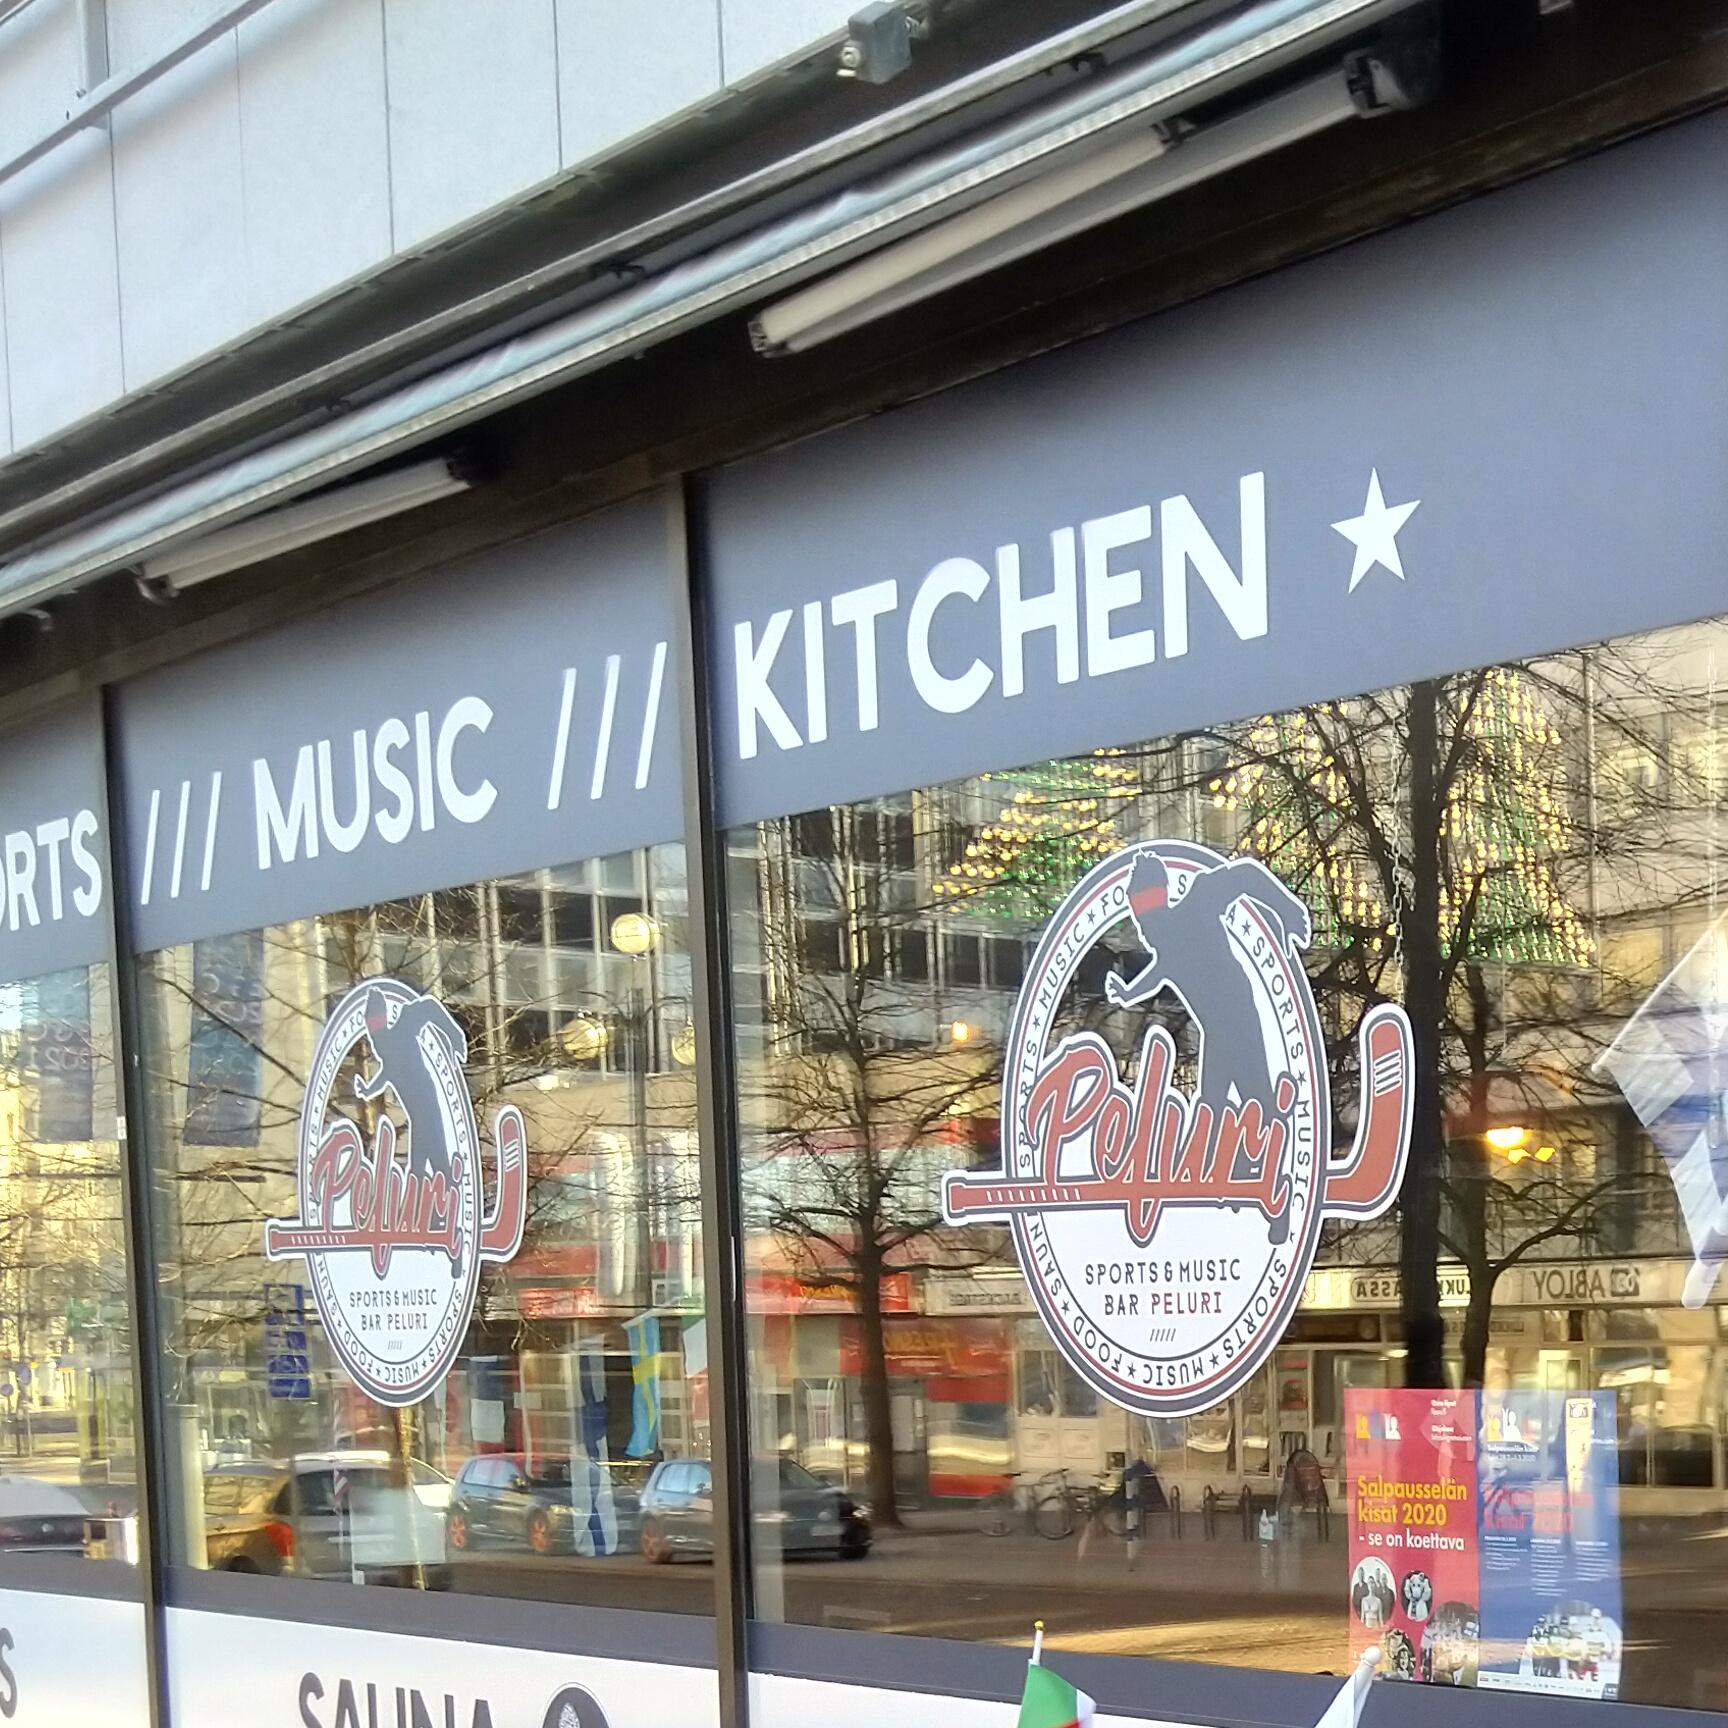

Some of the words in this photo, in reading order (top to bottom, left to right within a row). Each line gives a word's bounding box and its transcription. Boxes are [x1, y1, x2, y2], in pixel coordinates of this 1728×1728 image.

[0, 808, 104, 933] RTS
[253, 695, 498, 870] MUSIC
[733, 470, 1269, 760] KITCHEN
[1039, 927, 1086, 1011] MUSIC
[1101, 885, 1125, 913] FO
[318, 1041, 342, 1100] MUSIC
[435, 1053, 466, 1143] SPORTS
[1251, 936, 1304, 1060] SPORTS
[1293, 1100, 1312, 1208] MUSIC
[1027, 1036, 1293, 1240] Peluri
[311, 1118, 466, 1278] Peluri
[317, 1254, 337, 1316] SAUN
[344, 1330, 374, 1371] FOOD
[385, 1367, 420, 1383] MUSIC
[361, 1315, 382, 1331] BAR
[387, 1313, 428, 1330] PELURI
[1029, 1212, 1062, 1297] SAUN
[1073, 1316, 1123, 1374] FOOD
[1143, 1360, 1205, 1387] MUSIC
[1223, 1258, 1288, 1355] SPORTS
[1104, 1294, 1139, 1316] BAR
[1151, 1291, 1222, 1315] PELURI
[1357, 1475, 1467, 1501] Salpausselän
[1358, 1502, 1398, 1525] kisat
[1402, 1503, 1447, 1526] 2020
[1368, 1534, 1383, 1546] se
[1386, 1534, 1403, 1548] on
[1406, 1528, 1464, 1550] koettava
